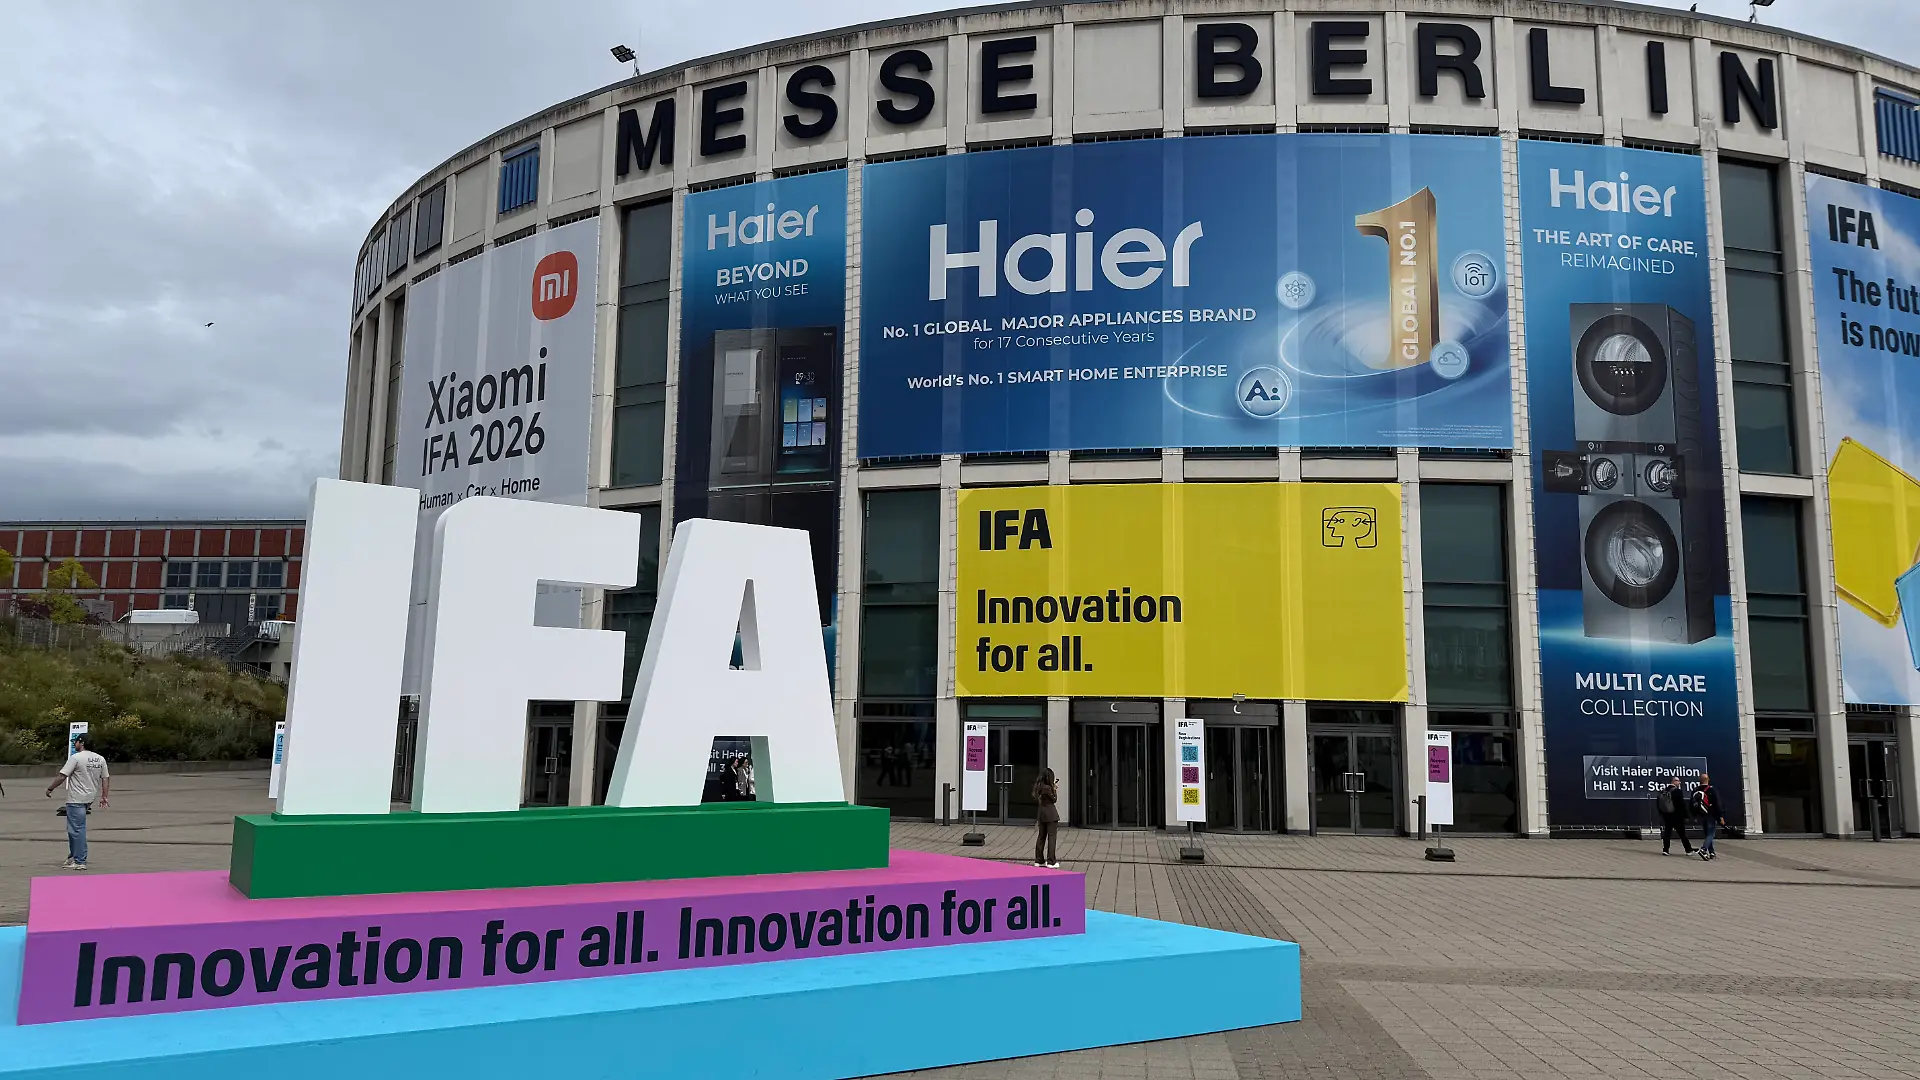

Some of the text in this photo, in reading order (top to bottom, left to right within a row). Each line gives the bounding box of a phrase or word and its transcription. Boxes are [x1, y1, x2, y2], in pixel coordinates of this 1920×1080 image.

[616, 21, 1778, 175] MESSE BERLIN
[1549, 168, 1676, 218] Haier
[707, 202, 819, 251] Haier
[1533, 228, 1698, 258] THE ART OF CARE,
[1827, 203, 1880, 250] IFA
[716, 258, 809, 287] BEYOND
[928, 208, 1204, 301] Haier
[1561, 252, 1675, 275] REIMAGINED
[715, 283, 809, 305] WHAT YOU SEE
[1399, 220, 1419, 360] GLOBAL NO.1
[1832, 266, 1920, 316] The fut
[883, 308, 1257, 339] No. 1 GLOBAL MAJOR APPLIANCES BRAND
[973, 330, 1155, 350] for 17 Consecutive Years
[1840, 311, 1864, 347] is
[424, 346, 548, 429] Xiaomi
[907, 364, 1228, 389] World's No. 1 SMART HOME ENTERPRISE
[421, 411, 545, 477] IFA 2026
[419, 491, 453, 511] Human
[466, 483, 487, 498] Car
[501, 477, 540, 496] Home
[978, 508, 1053, 551] IFA
[976, 587, 1183, 624] Innovation
[277, 478, 845, 815] IFA
[976, 635, 1094, 673] for all.
[1575, 672, 1707, 693] MULTI CARE
[1580, 698, 1704, 717] COLLECTION
[709, 749, 748, 759] sit Haier
[1591, 764, 1700, 777] Visit Haier Pavilion
[1593, 780, 1616, 791] Hall
[1620, 780, 1635, 791] 3.1
[1647, 781, 1681, 792] Sta
[73, 884, 1062, 1008] Innovation for all. Innovation for all.
